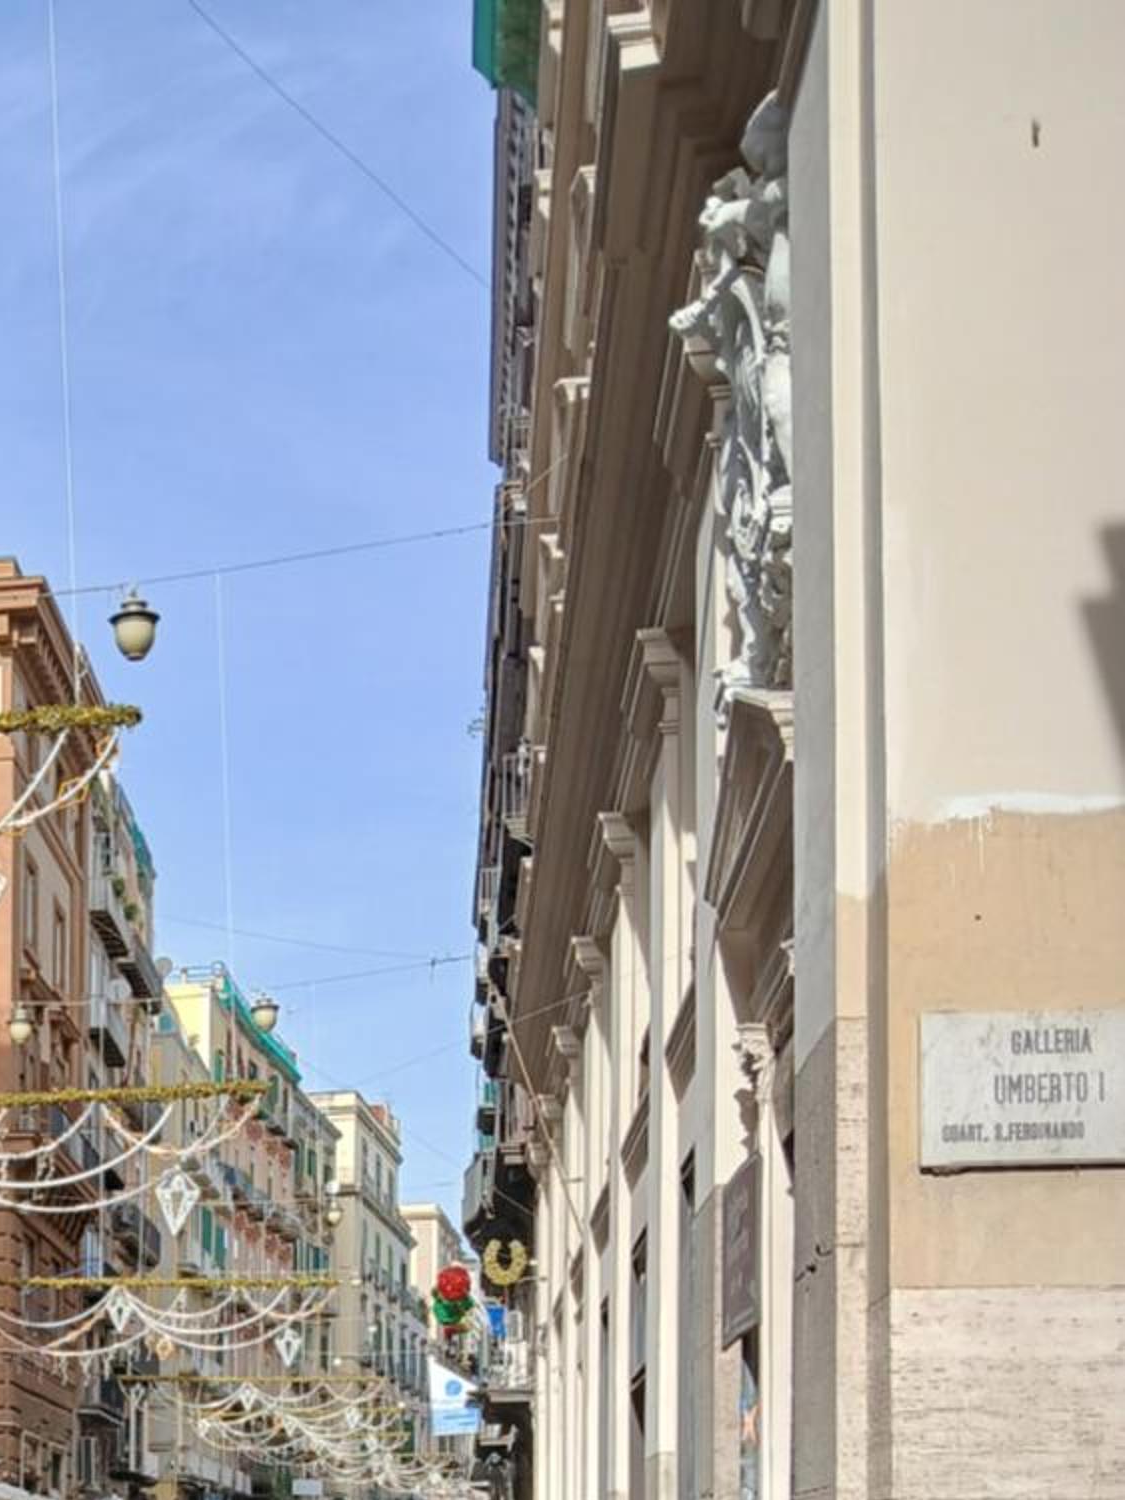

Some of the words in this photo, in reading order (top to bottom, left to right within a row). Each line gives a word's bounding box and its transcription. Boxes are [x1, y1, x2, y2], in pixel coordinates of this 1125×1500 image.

[1010, 1027, 1093, 1055] GALLERIA
[994, 1071, 1088, 1104] UMBERTO
[1098, 1071, 1106, 1101] I
